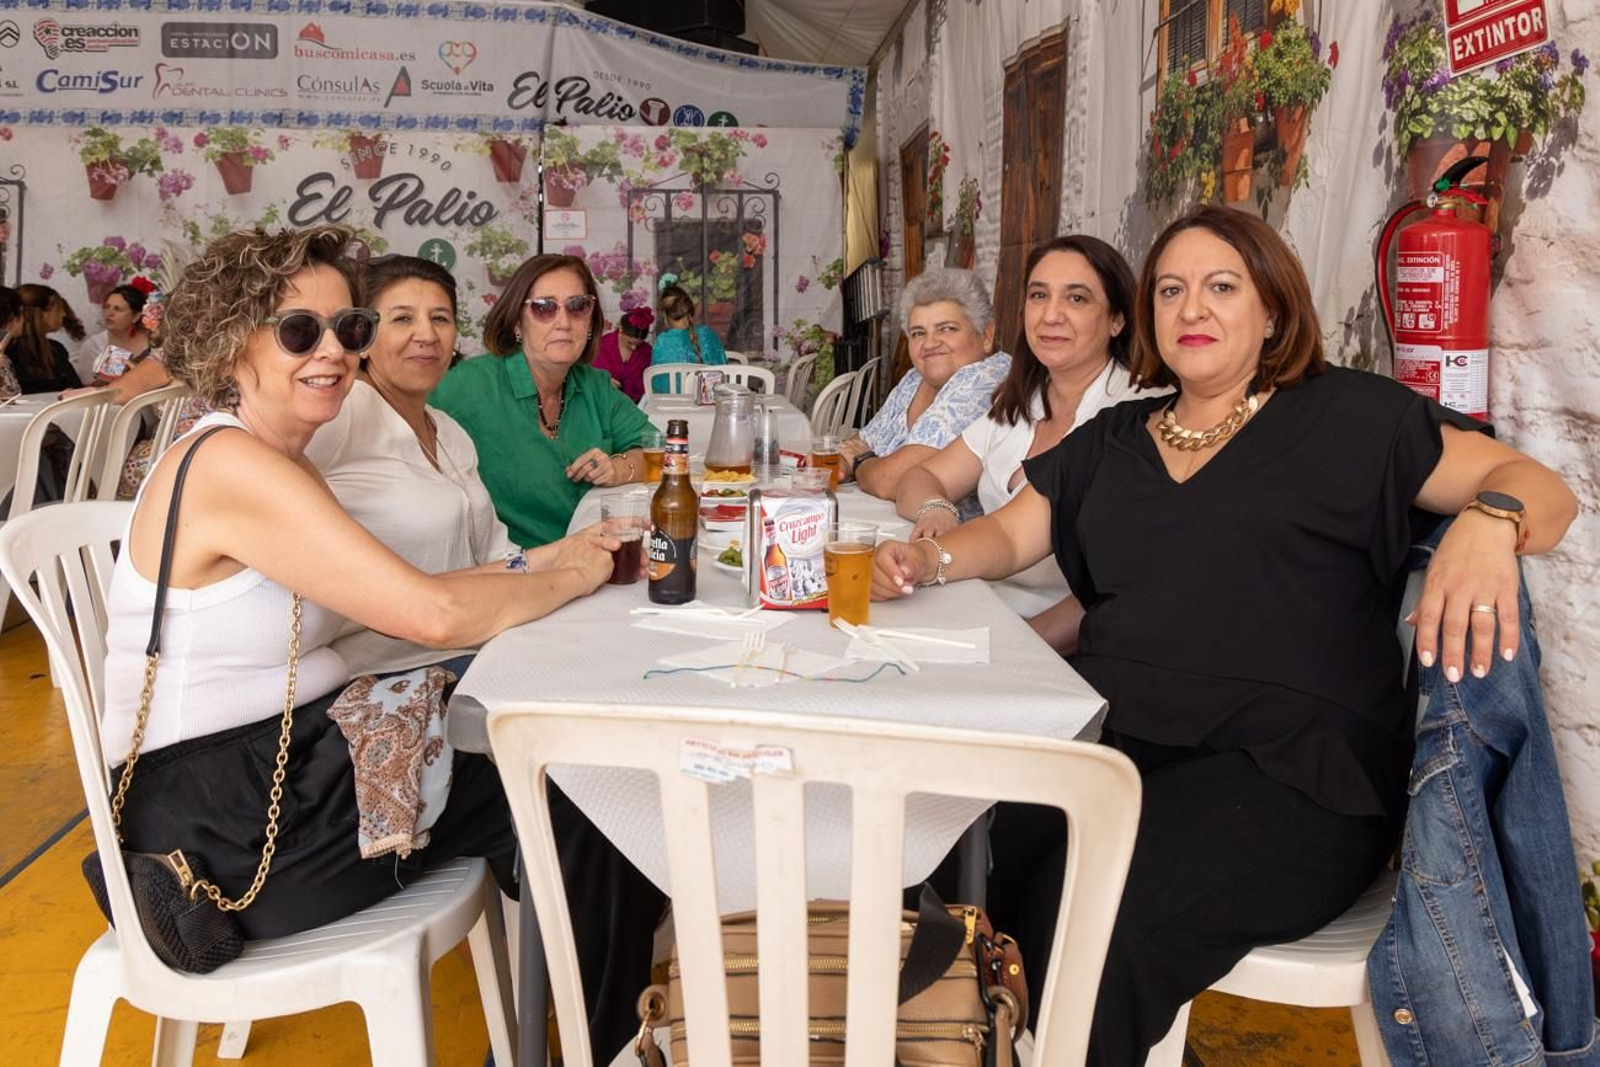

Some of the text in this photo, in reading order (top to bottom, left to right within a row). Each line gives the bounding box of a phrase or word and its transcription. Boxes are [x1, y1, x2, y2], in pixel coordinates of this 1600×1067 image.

[61, 24, 138, 37] creaccion
[1453, 7, 1544, 61] EXTINTOR
[294, 45, 416, 60] buscomicasa.es
[36, 69, 143, 93] CamiSur
[421, 79, 462, 90] Scuola
[470, 80, 494, 92] Vita
[593, 70, 651, 90] DESDE 1990
[507, 71, 636, 122] El Palio
[340, 142, 453, 172] SINCE 1990
[287, 171, 500, 229] El Palio
[779, 512, 825, 532] Cruzcampo
[791, 524, 818, 545] Light
